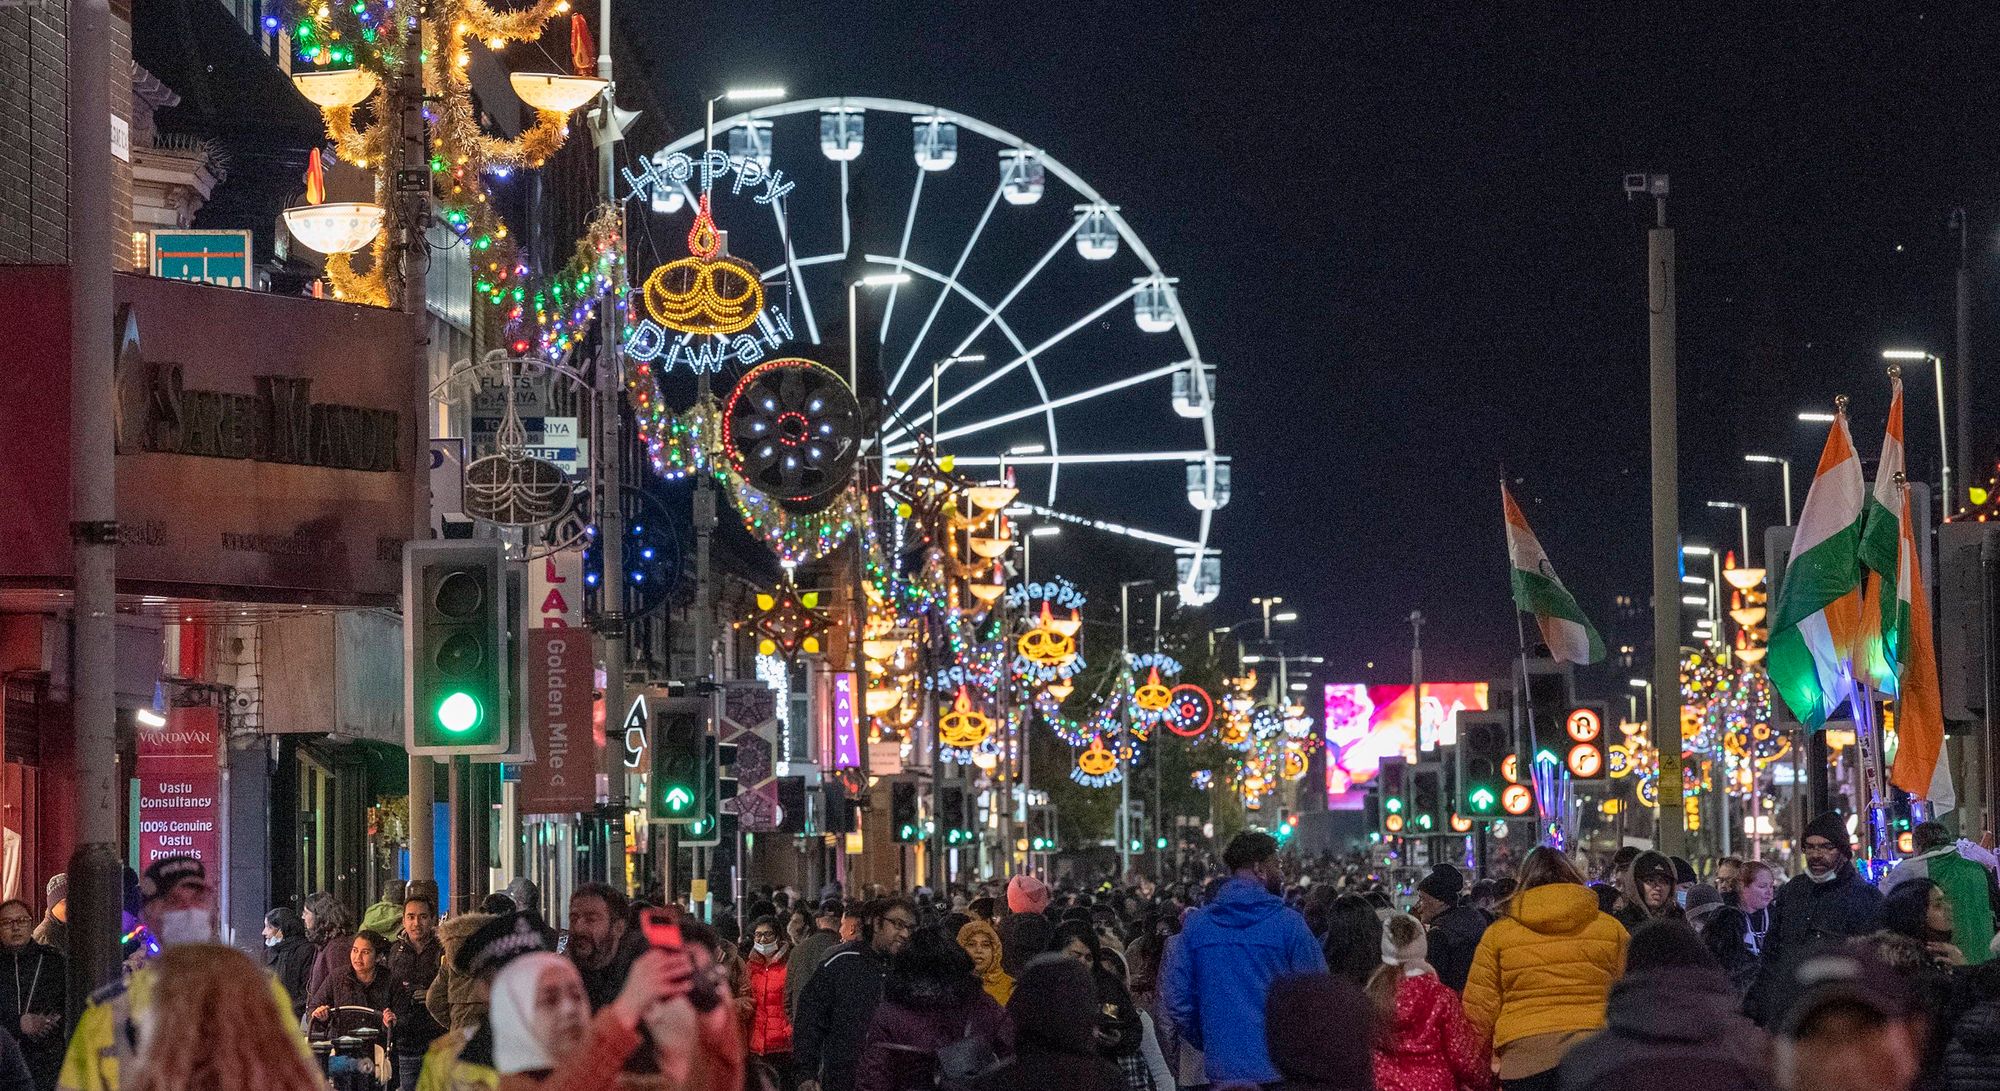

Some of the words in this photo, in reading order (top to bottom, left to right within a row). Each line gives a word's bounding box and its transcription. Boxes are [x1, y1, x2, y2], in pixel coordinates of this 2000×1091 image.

[621, 149, 795, 204] Happy
[624, 305, 793, 375] Diwali
[481, 378, 530, 390] FLTS
[543, 423, 570, 434] RIYA
[1009, 581, 1087, 609] Happy
[546, 639, 567, 717] Golden
[837, 679, 850, 765] KAVYA
[548, 722, 568, 769] Mile
[159, 782, 192, 794] Vastu
[140, 796, 212, 808] Consultancy
[140, 821, 168, 833] 100%
[170, 820, 213, 832] Genuine
[159, 834, 192, 846] Vastu
[150, 848, 202, 861] Products
